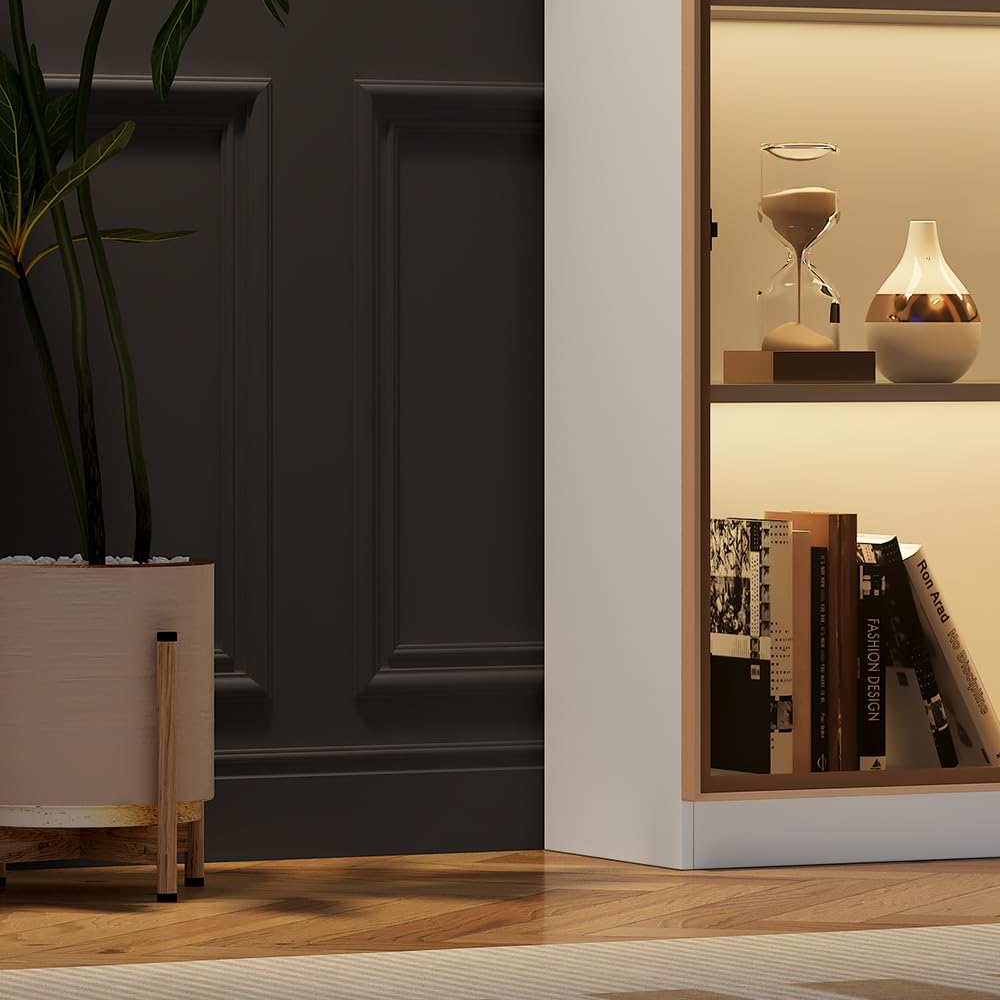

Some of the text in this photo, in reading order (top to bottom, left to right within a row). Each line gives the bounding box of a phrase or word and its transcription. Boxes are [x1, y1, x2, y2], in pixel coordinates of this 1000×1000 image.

[866, 618, 880, 721] FASHION DESIGN
[917, 559, 988, 715] Ron Arad No Discipline
